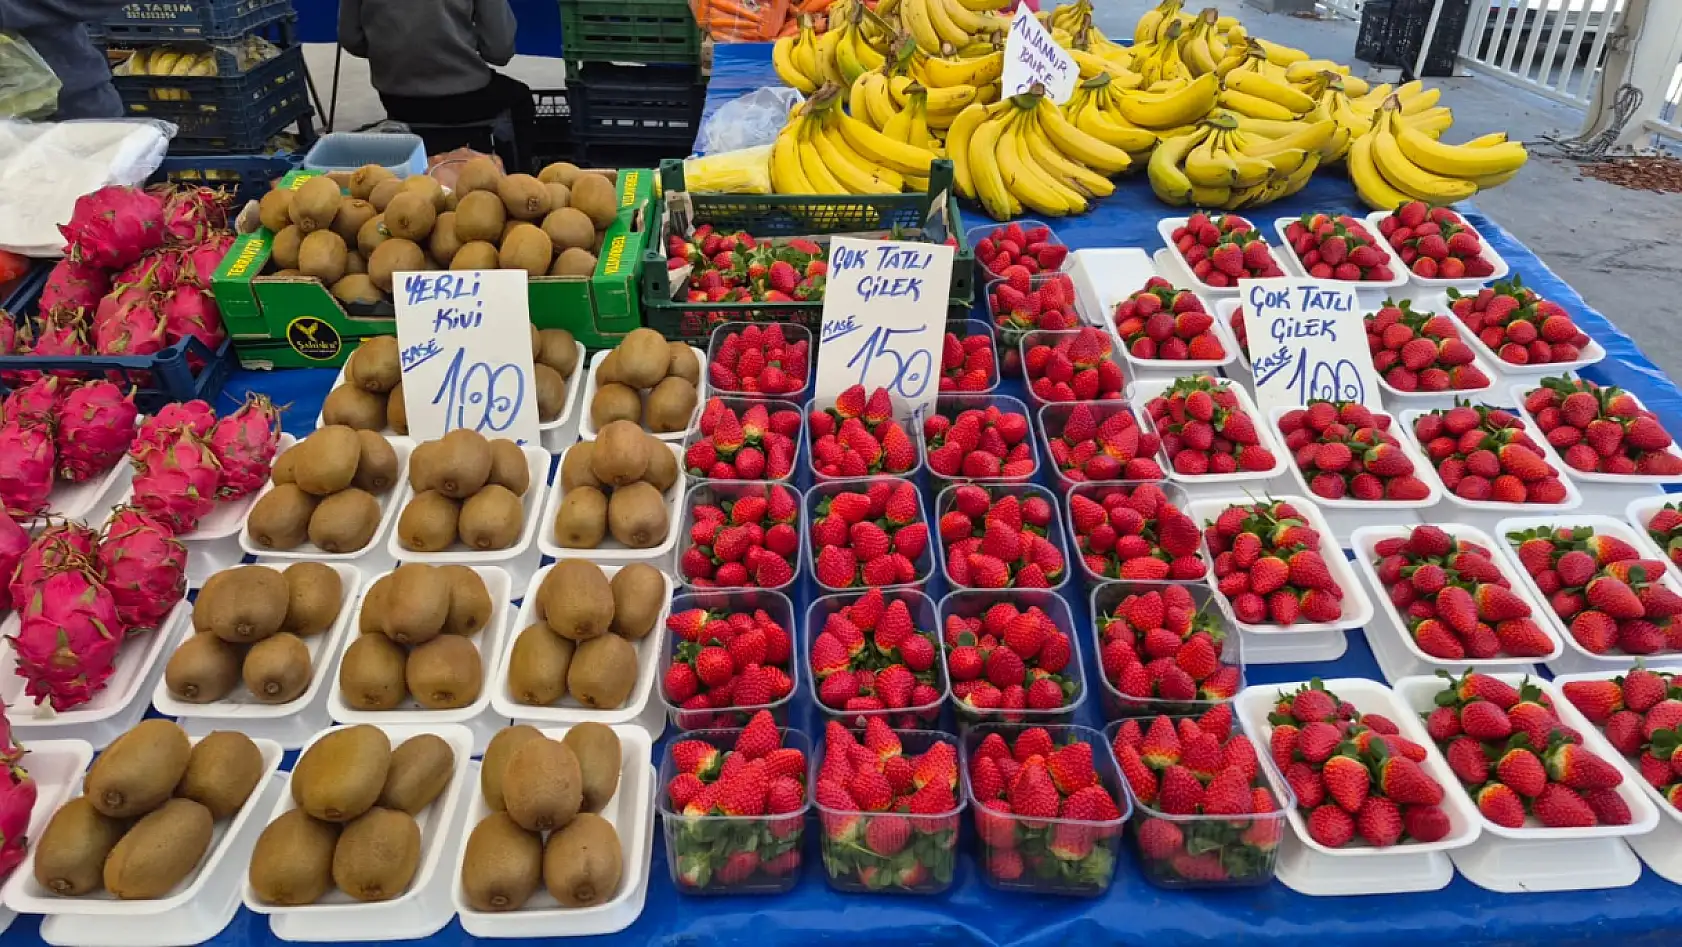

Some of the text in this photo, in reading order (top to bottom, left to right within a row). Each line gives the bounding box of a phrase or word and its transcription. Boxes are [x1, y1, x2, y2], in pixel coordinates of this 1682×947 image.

[143, 3, 193, 12] TARIM
[833, 246, 933, 279] ÇOK TATLI
[1250, 285, 1353, 317] ÇOK TATLI
[847, 324, 932, 398] 150
[1286, 347, 1365, 407] 100
[432, 347, 525, 434] 100
